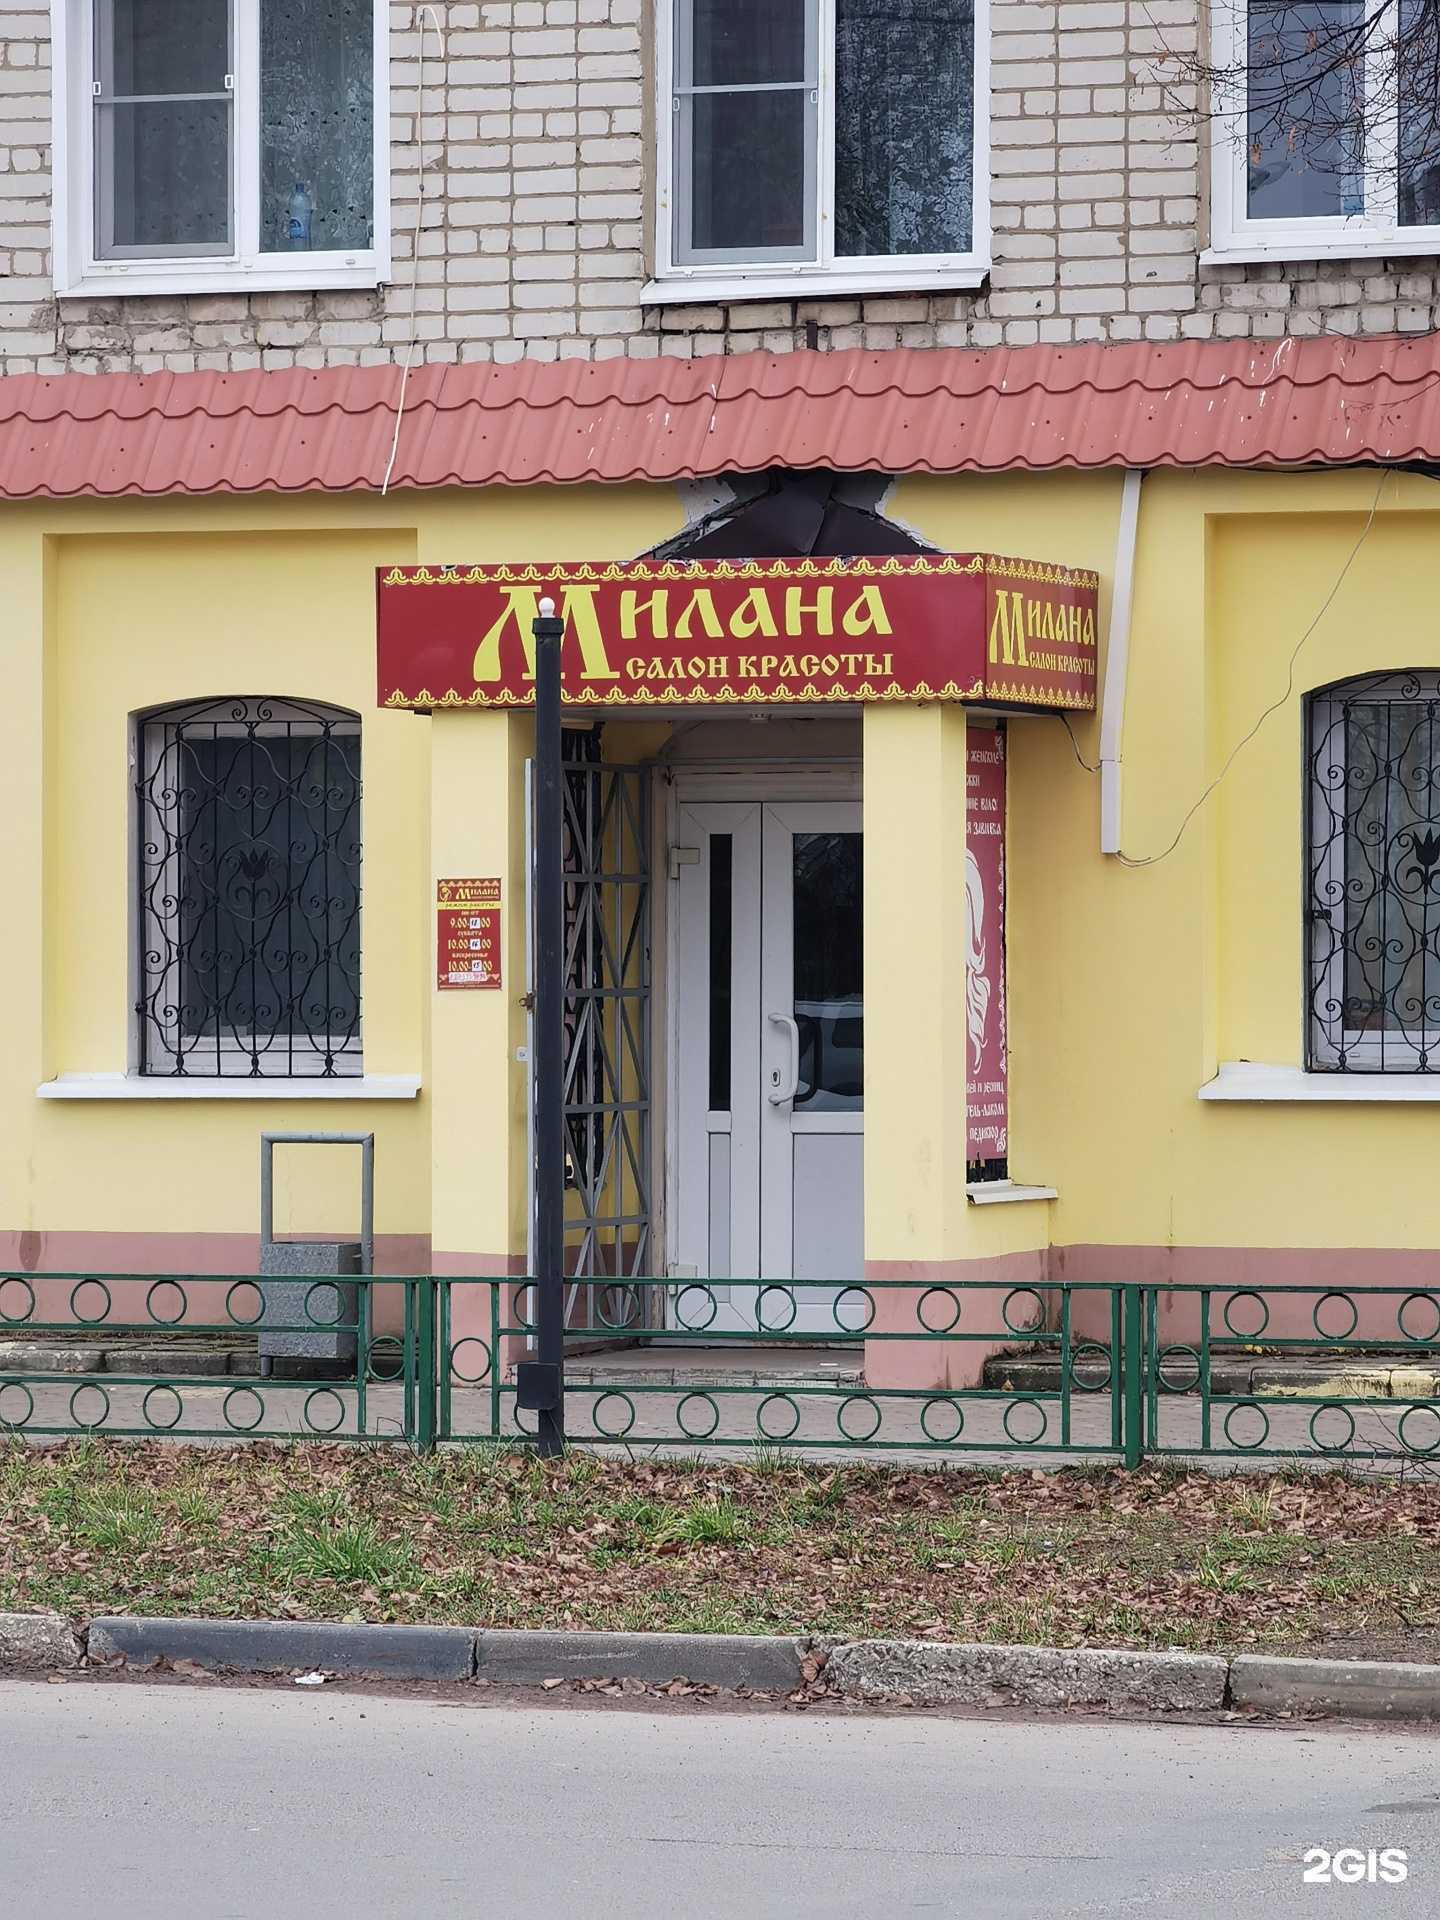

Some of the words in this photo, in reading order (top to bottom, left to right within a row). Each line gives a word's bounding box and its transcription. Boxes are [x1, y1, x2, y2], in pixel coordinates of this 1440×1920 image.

[626, 655, 732, 680] САЛОН
[737, 653, 895, 679] КРАСОТЫ
[1029, 651, 1058, 670] САЛОН
[1058, 654, 1095, 676] КРАСОТЫ
